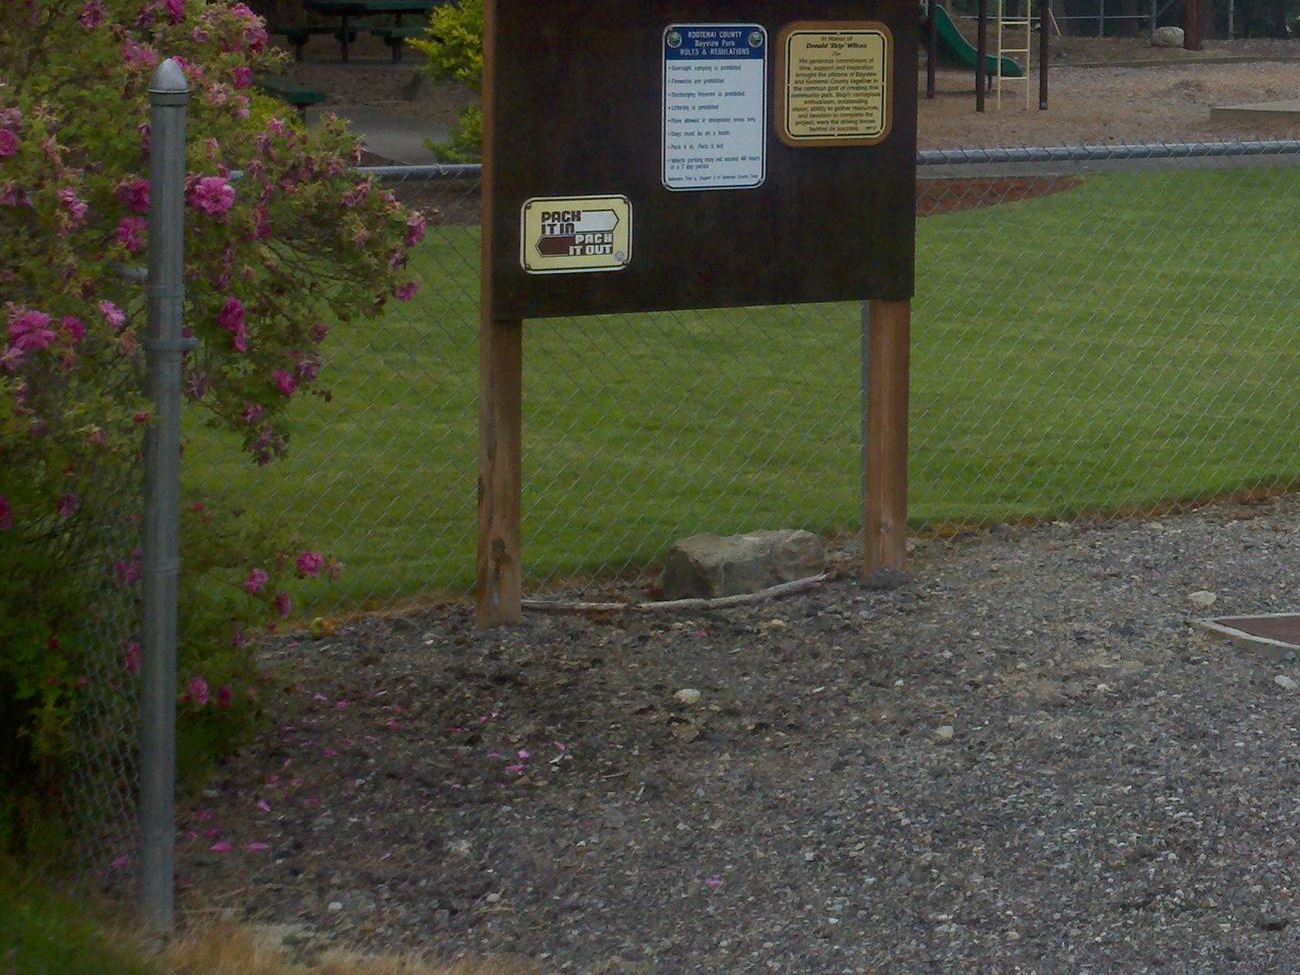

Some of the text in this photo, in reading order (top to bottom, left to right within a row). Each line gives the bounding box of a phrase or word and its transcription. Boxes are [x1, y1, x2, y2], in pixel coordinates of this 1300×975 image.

[680, 48, 699, 56] RULES
[710, 48, 750, 56] REGULATIONS
[541, 211, 581, 223] PACK
[541, 223, 575, 235] IT IN
[575, 233, 613, 244] PACK
[569, 244, 612, 255] IT OUT
